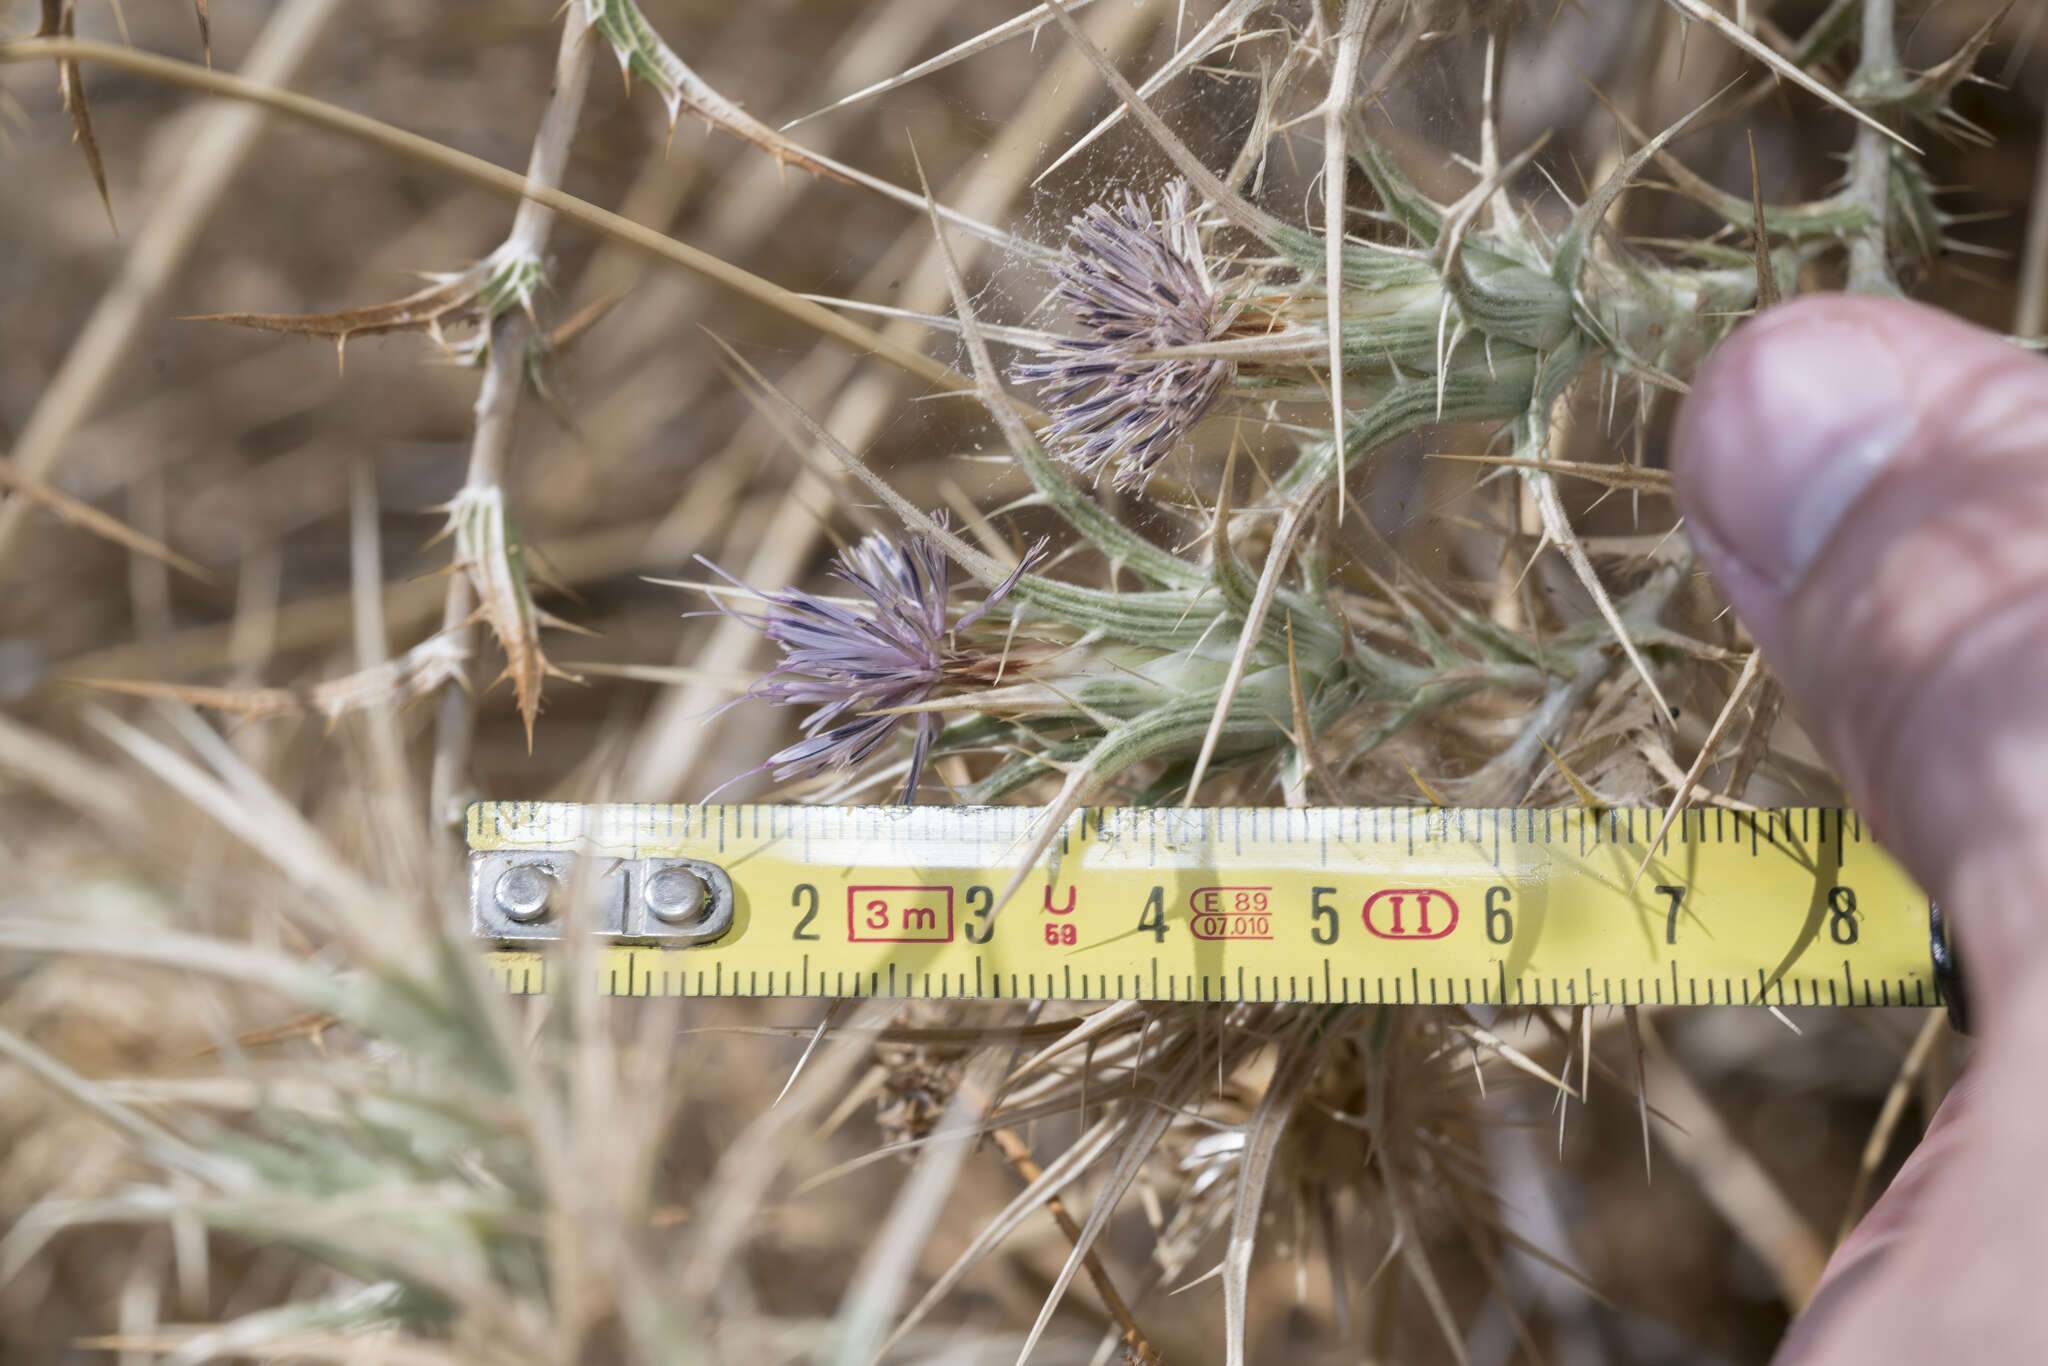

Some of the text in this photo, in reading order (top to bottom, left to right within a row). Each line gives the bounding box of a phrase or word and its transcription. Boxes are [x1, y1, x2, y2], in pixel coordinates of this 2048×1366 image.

[792, 883, 820, 940] 2
[866, 900, 935, 930] 3 m
[965, 886, 994, 944] 3
[1045, 885, 1077, 915] U
[1138, 886, 1170, 943] 4
[1204, 917, 1270, 936] 07.010
[1235, 893, 1268, 911] 89
[1311, 886, 1339, 945] 5
[1389, 895, 1432, 934] II
[1485, 886, 1514, 944] 6
[1655, 886, 1686, 944] 7
[1828, 886, 1859, 945] 8
